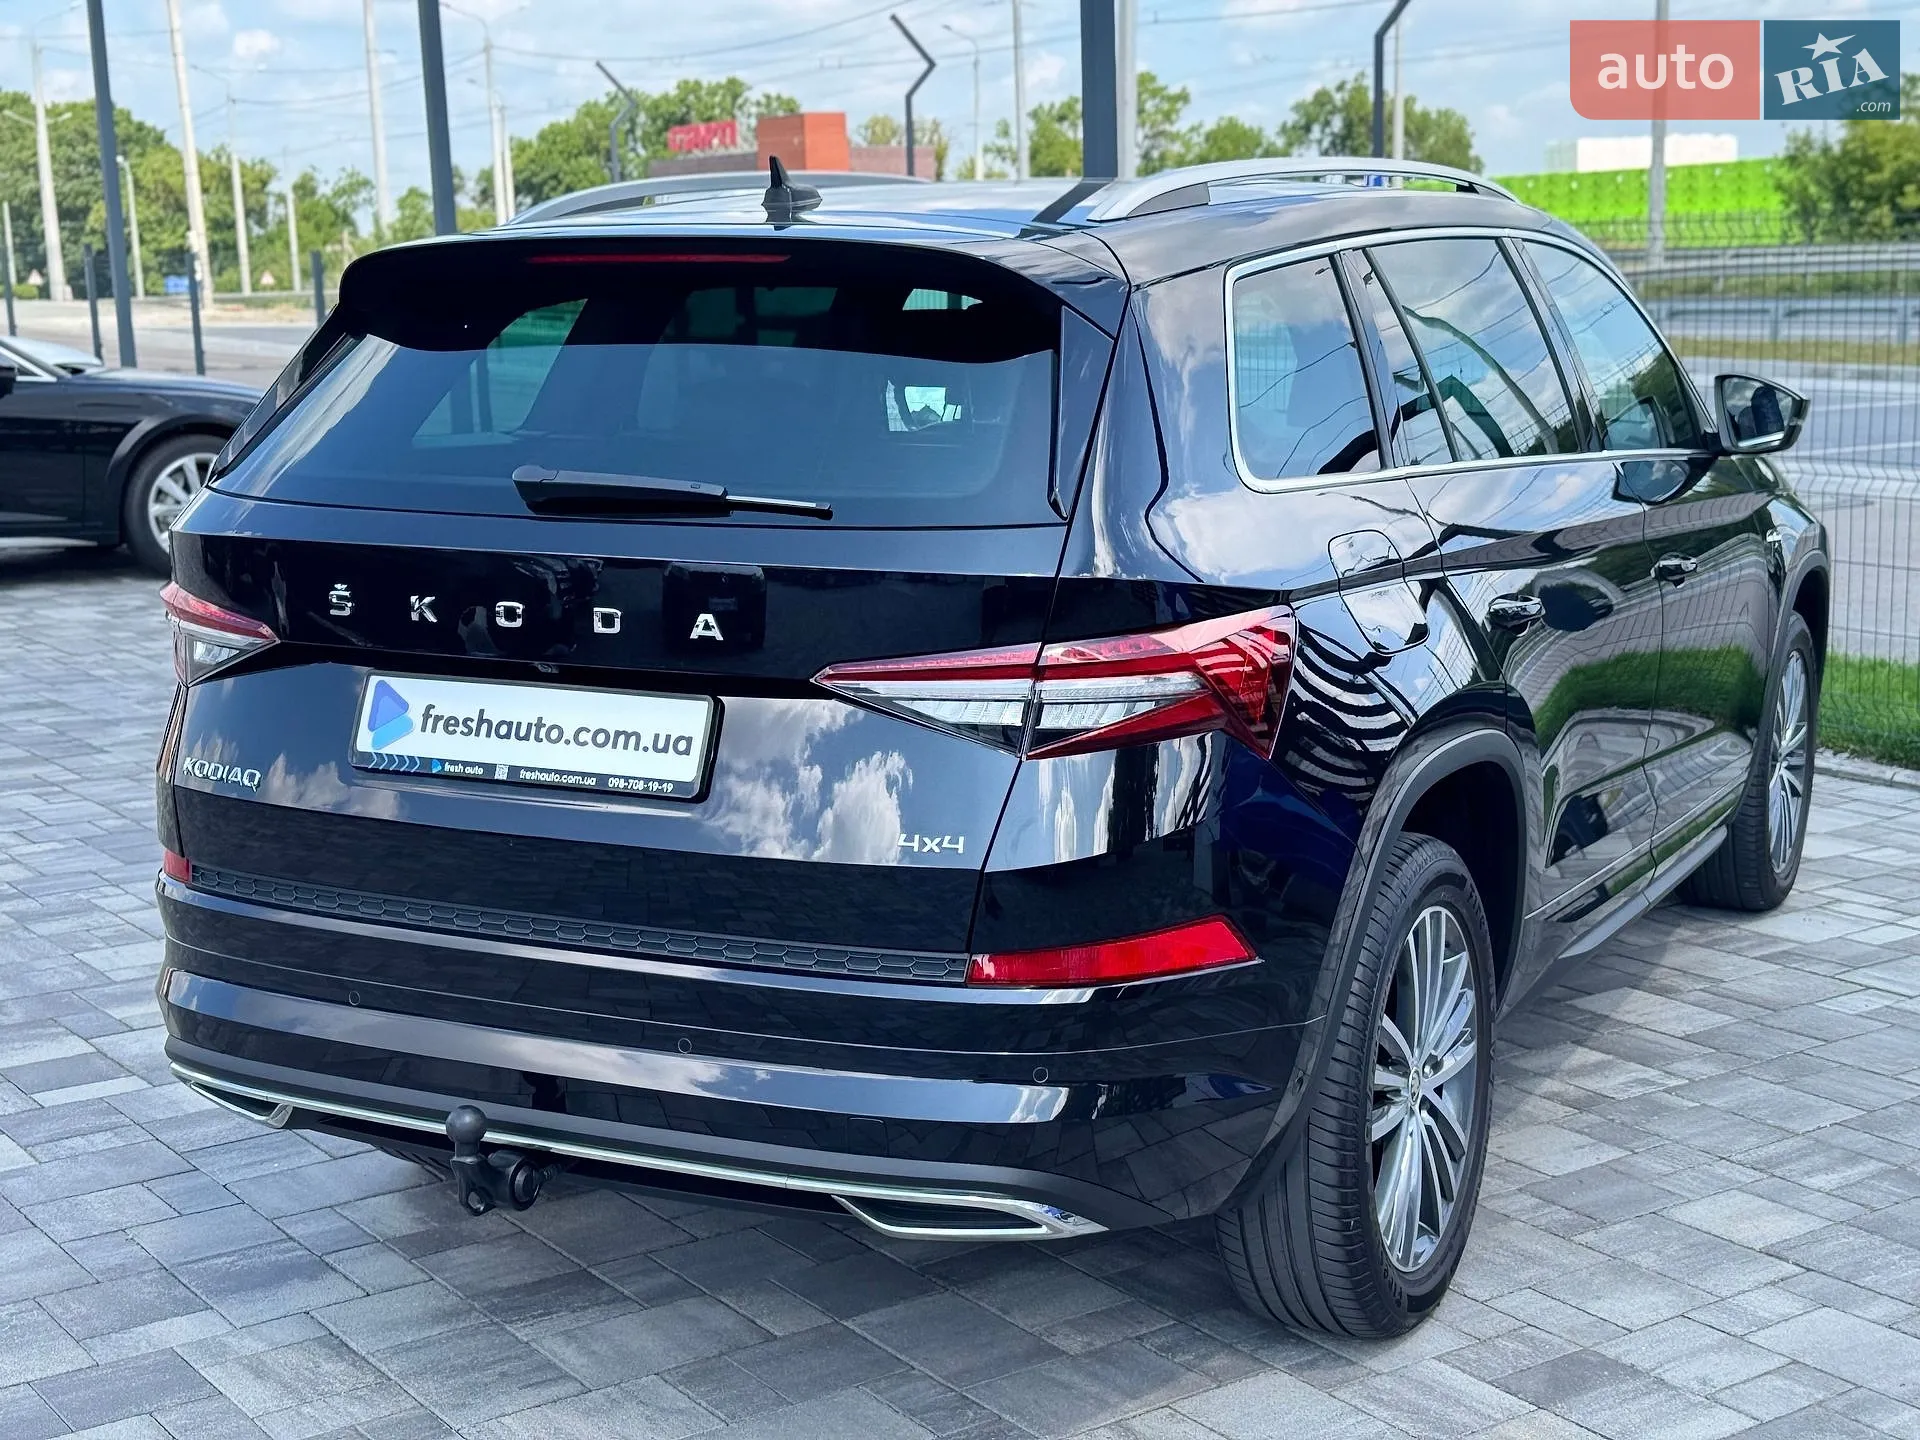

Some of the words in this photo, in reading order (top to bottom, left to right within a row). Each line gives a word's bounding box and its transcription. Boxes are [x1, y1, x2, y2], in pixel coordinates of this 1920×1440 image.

[329, 583, 724, 641] ŠKODA
[420, 703, 694, 756] freshauto.com.ua
[183, 757, 261, 792] KODIAQ
[444, 762, 464, 774] fresh
[465, 765, 484, 775] auto
[519, 768, 597, 786] freshauto.com.ua
[898, 833, 965, 854] 4x4
